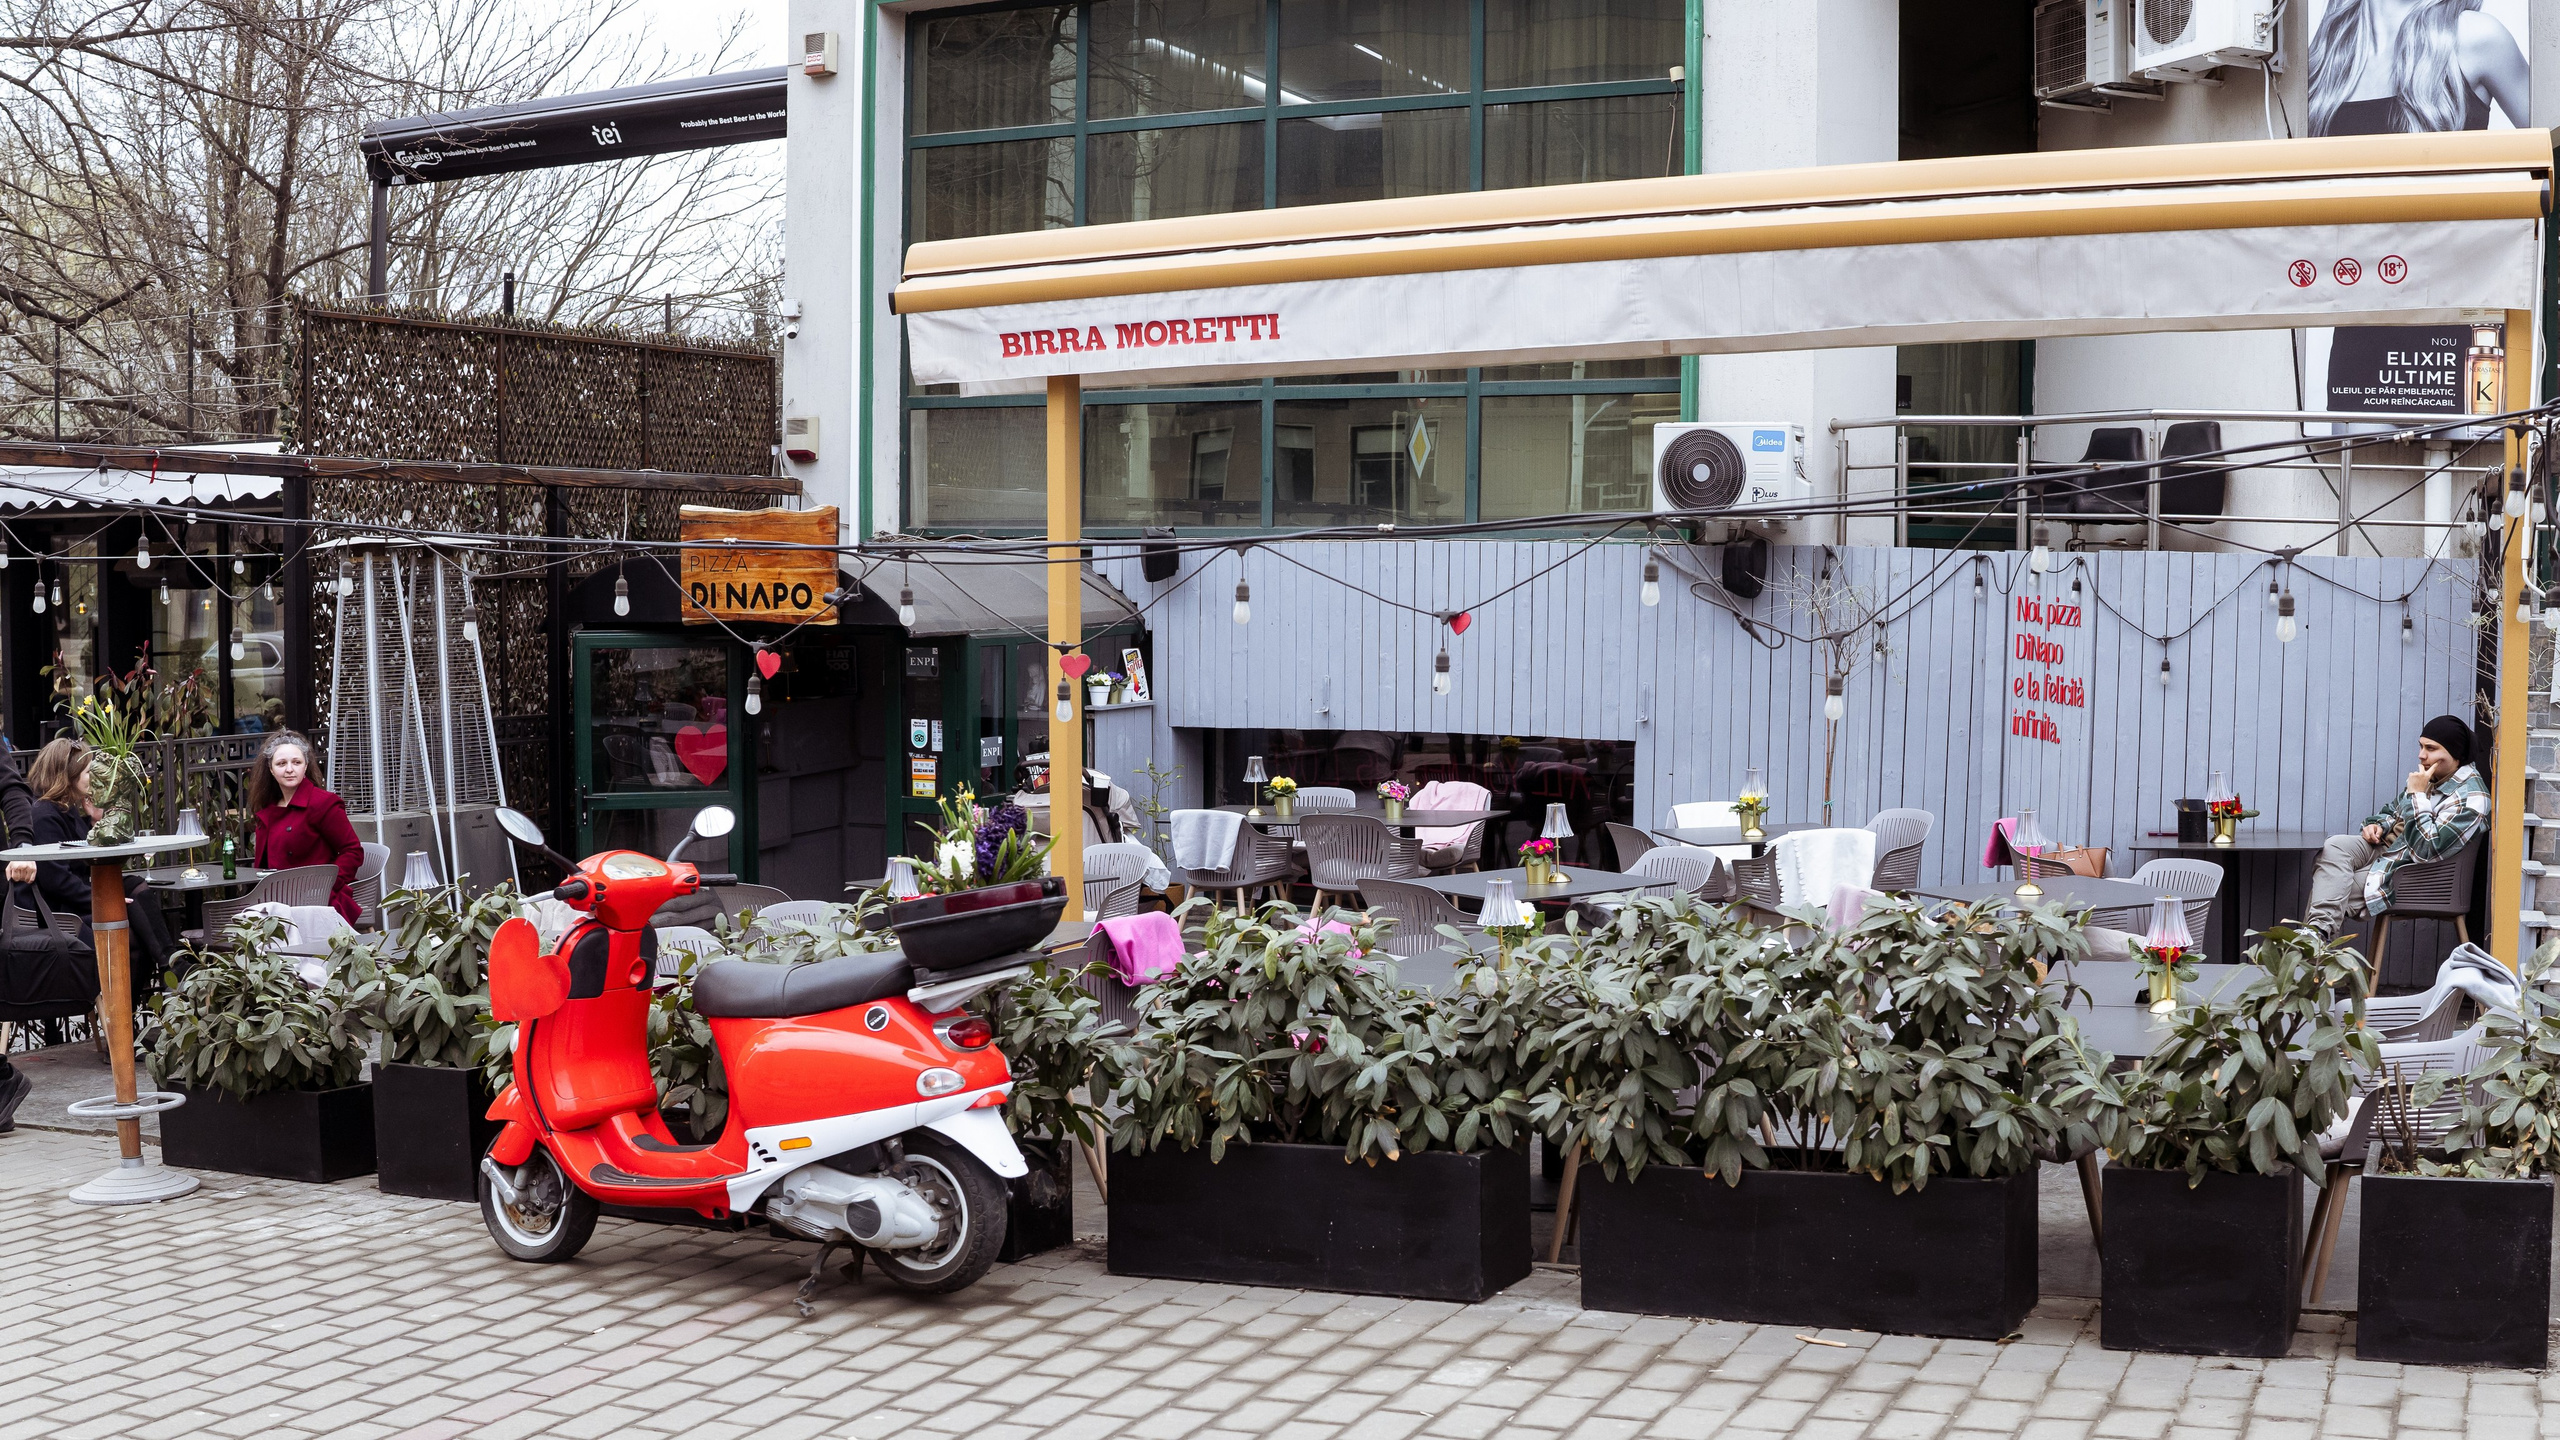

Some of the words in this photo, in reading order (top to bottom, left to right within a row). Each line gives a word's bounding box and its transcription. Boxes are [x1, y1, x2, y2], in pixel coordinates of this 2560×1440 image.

[680, 120, 708, 128] Probably
[708, 117, 718, 125] the
[719, 116, 733, 124] Best
[733, 115, 748, 123] Beer
[756, 112, 767, 120] the
[766, 109, 786, 118] World
[591, 121, 622, 146] tei
[395, 147, 442, 169] Carlsberg
[441, 149, 466, 158] Probably
[518, 139, 537, 147] World
[2383, 262, 2403, 277] 18+
[999, 325, 1107, 359] BIRRA
[1114, 313, 1281, 349] MORETTI
[2431, 337, 2457, 346] NOU
[2386, 351, 2457, 367] ELIXIR
[2379, 369, 2456, 385] ULTIME
[2331, 386, 2362, 395] ULEIUL
[2364, 387, 2377, 395] DE
[2378, 386, 2396, 395] PĂR
[2398, 387, 2456, 397] EMBLEMATIC,
[2476, 380, 2493, 402] K
[2363, 397, 2389, 406] ACUM
[2391, 396, 2456, 407] REÎNCĂRCABIL
[1754, 435, 1783, 447] Midea
[690, 555, 749, 573] PIZZA
[691, 582, 717, 610] DI
[725, 582, 813, 610] NAPO
[2017, 594, 2043, 626] Noi,
[2046, 596, 2082, 632] pizza
[2015, 632, 2064, 670] DiNapo
[909, 656, 936, 667] ENPI
[2013, 677, 2024, 698] e
[2027, 671, 2040, 702] la
[2043, 673, 2085, 709] felicità
[2012, 707, 2061, 744] infinita.
[982, 746, 1000, 758] ENPI
